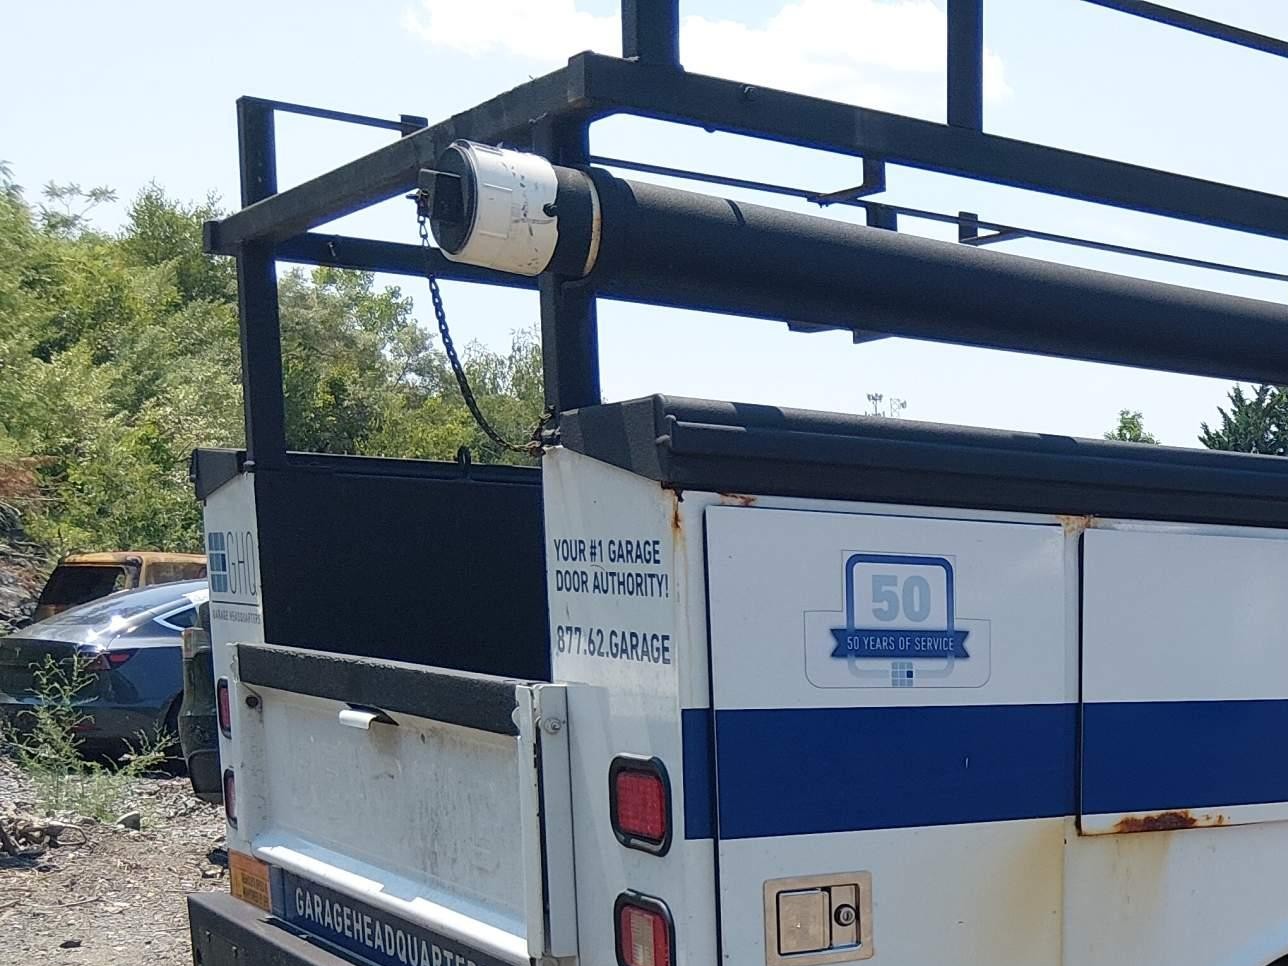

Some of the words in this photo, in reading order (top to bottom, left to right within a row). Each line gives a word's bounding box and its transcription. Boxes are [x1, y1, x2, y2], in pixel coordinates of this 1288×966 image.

[226, 531, 257, 596] GHQ
[554, 539, 586, 562] YOUR
[590, 542, 604, 563] #1
[608, 540, 661, 564] GARAGE
[556, 570, 589, 593] DOOR
[592, 571, 669, 598] AUTHORITY!
[871, 574, 931, 623] 50
[556, 625, 671, 665] 877.62.GARAGE
[847, 636, 860, 651] 50
[863, 636, 895, 651] YEARS
[898, 636, 911, 651] OF
[914, 637, 954, 652] SERVICE
